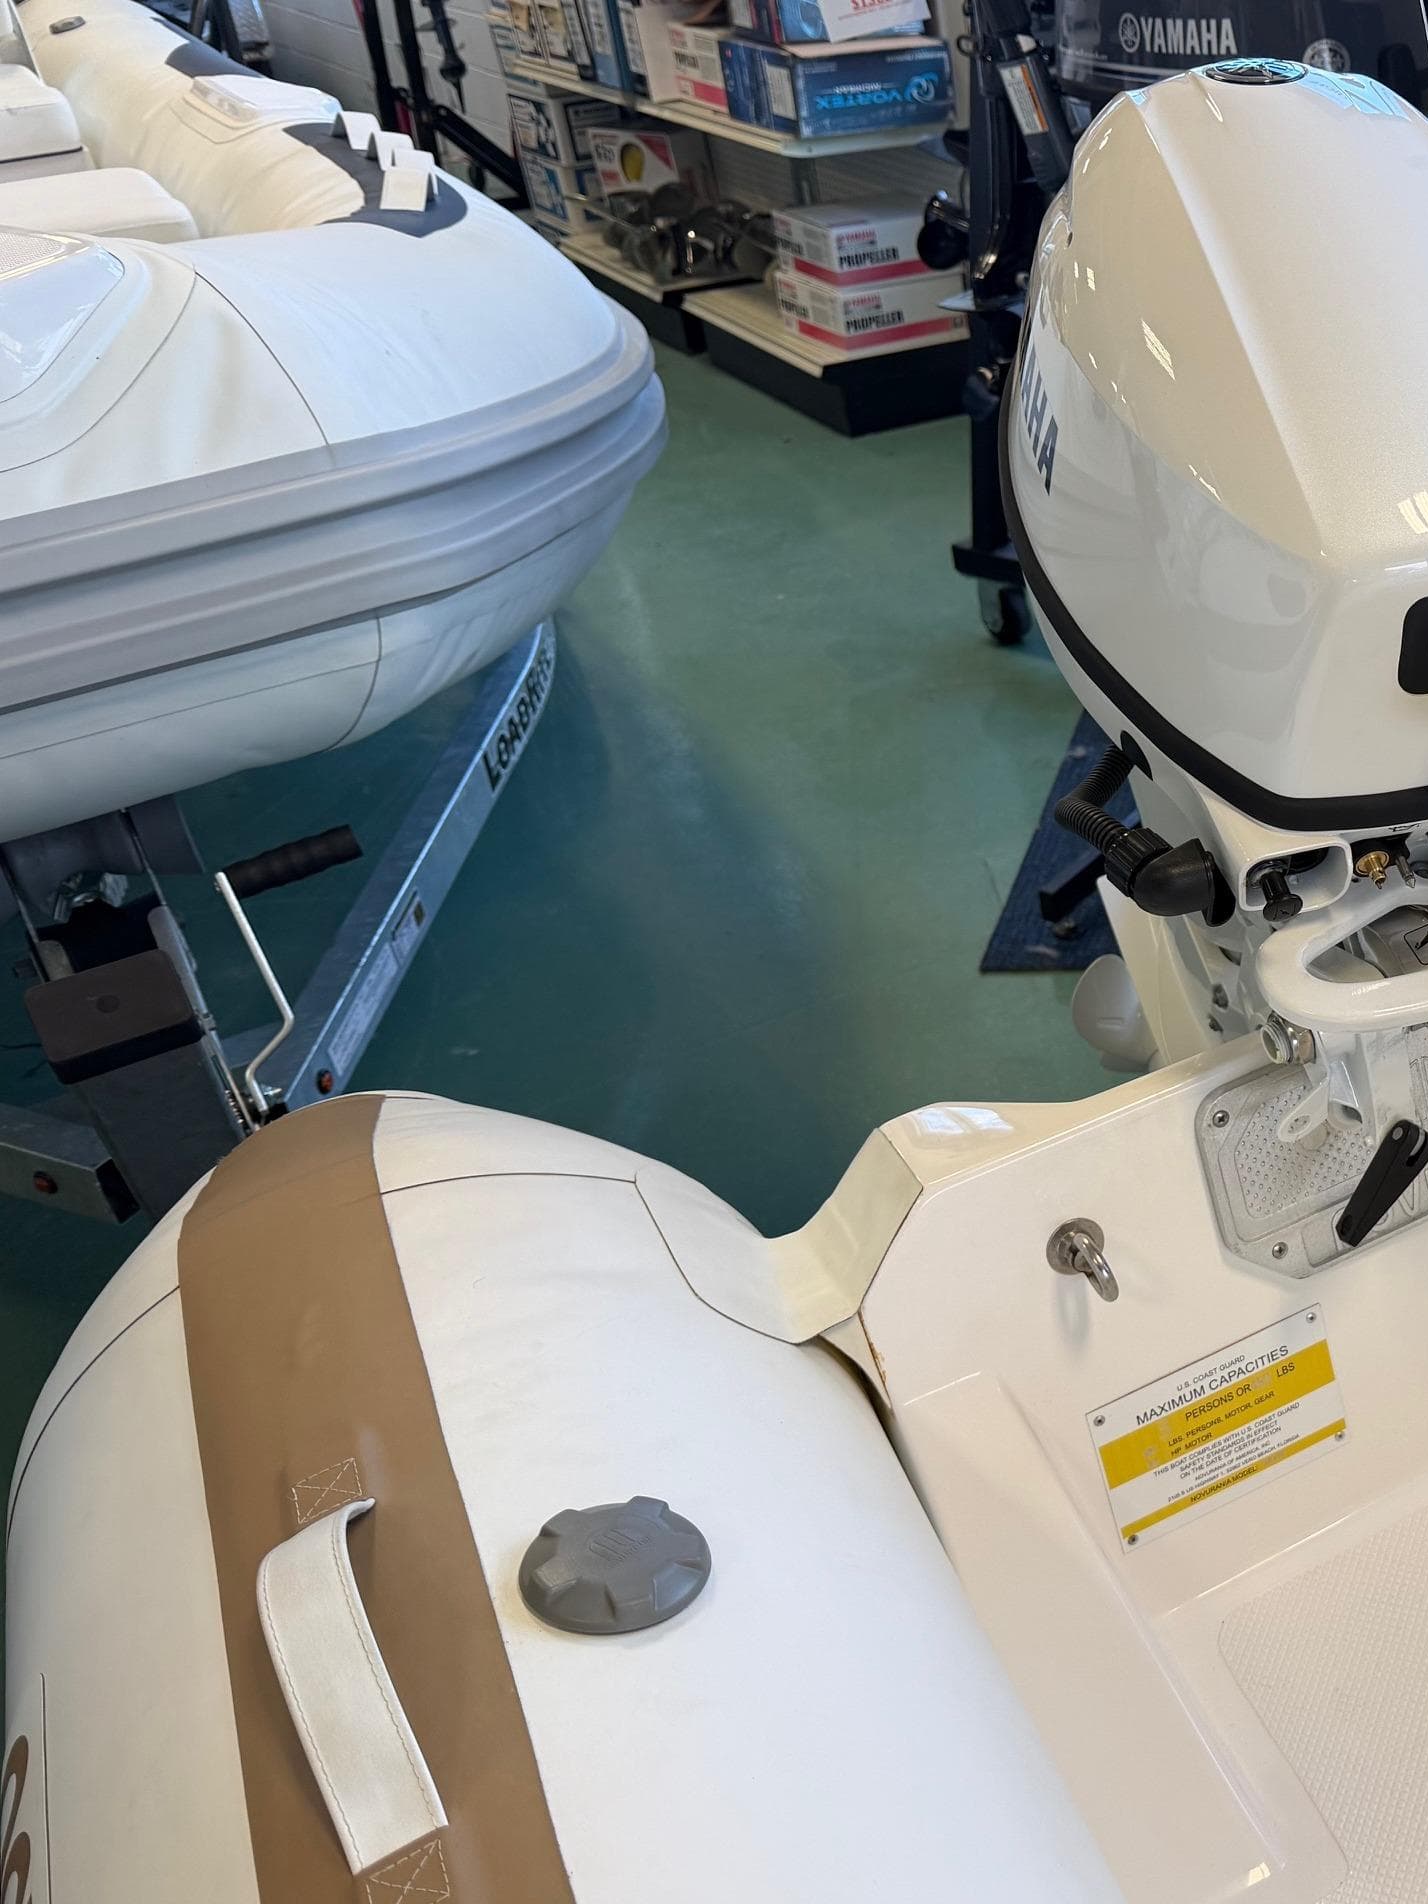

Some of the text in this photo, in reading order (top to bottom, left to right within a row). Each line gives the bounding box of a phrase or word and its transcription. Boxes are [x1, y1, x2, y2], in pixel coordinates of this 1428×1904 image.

[1140, 17, 1238, 55] YAMAHA
[815, 90, 903, 110] VORTEX
[839, 246, 900, 269] PROPELLER
[846, 310, 904, 334] PROPELLER
[1193, 1367, 1217, 1384] COAST
[1220, 1354, 1245, 1372] GUARD
[1136, 1385, 1206, 1426] MAXIMUM
[1208, 1345, 1289, 1391] CAPACITIES
[1185, 1362, 1295, 1422] PERSONS OR LBS
[1254, 1391, 1275, 1405] GEAR
[1153, 1467, 1169, 1477] THIS
[1170, 1456, 1188, 1469] BOAT
[1189, 1442, 1223, 1460] COMPLIES
[1223, 1432, 1241, 1445] WITH
[1254, 1413, 1276, 1428] COAST
[1277, 1401, 1300, 1417] GUARD
[1180, 1457, 1206, 1472] SAFETY
[1206, 1438, 1246, 1459] STANDARDS
[1254, 1420, 1278, 1436] EFFECT
[1185, 1432, 1212, 1449] MOTOR
[1191, 1463, 1205, 1475] THE
[1205, 1454, 1223, 1467] DATE
[1233, 1426, 1281, 1453] CERTIFICATION
[1190, 1478, 1232, 1503] NOVURANIA
